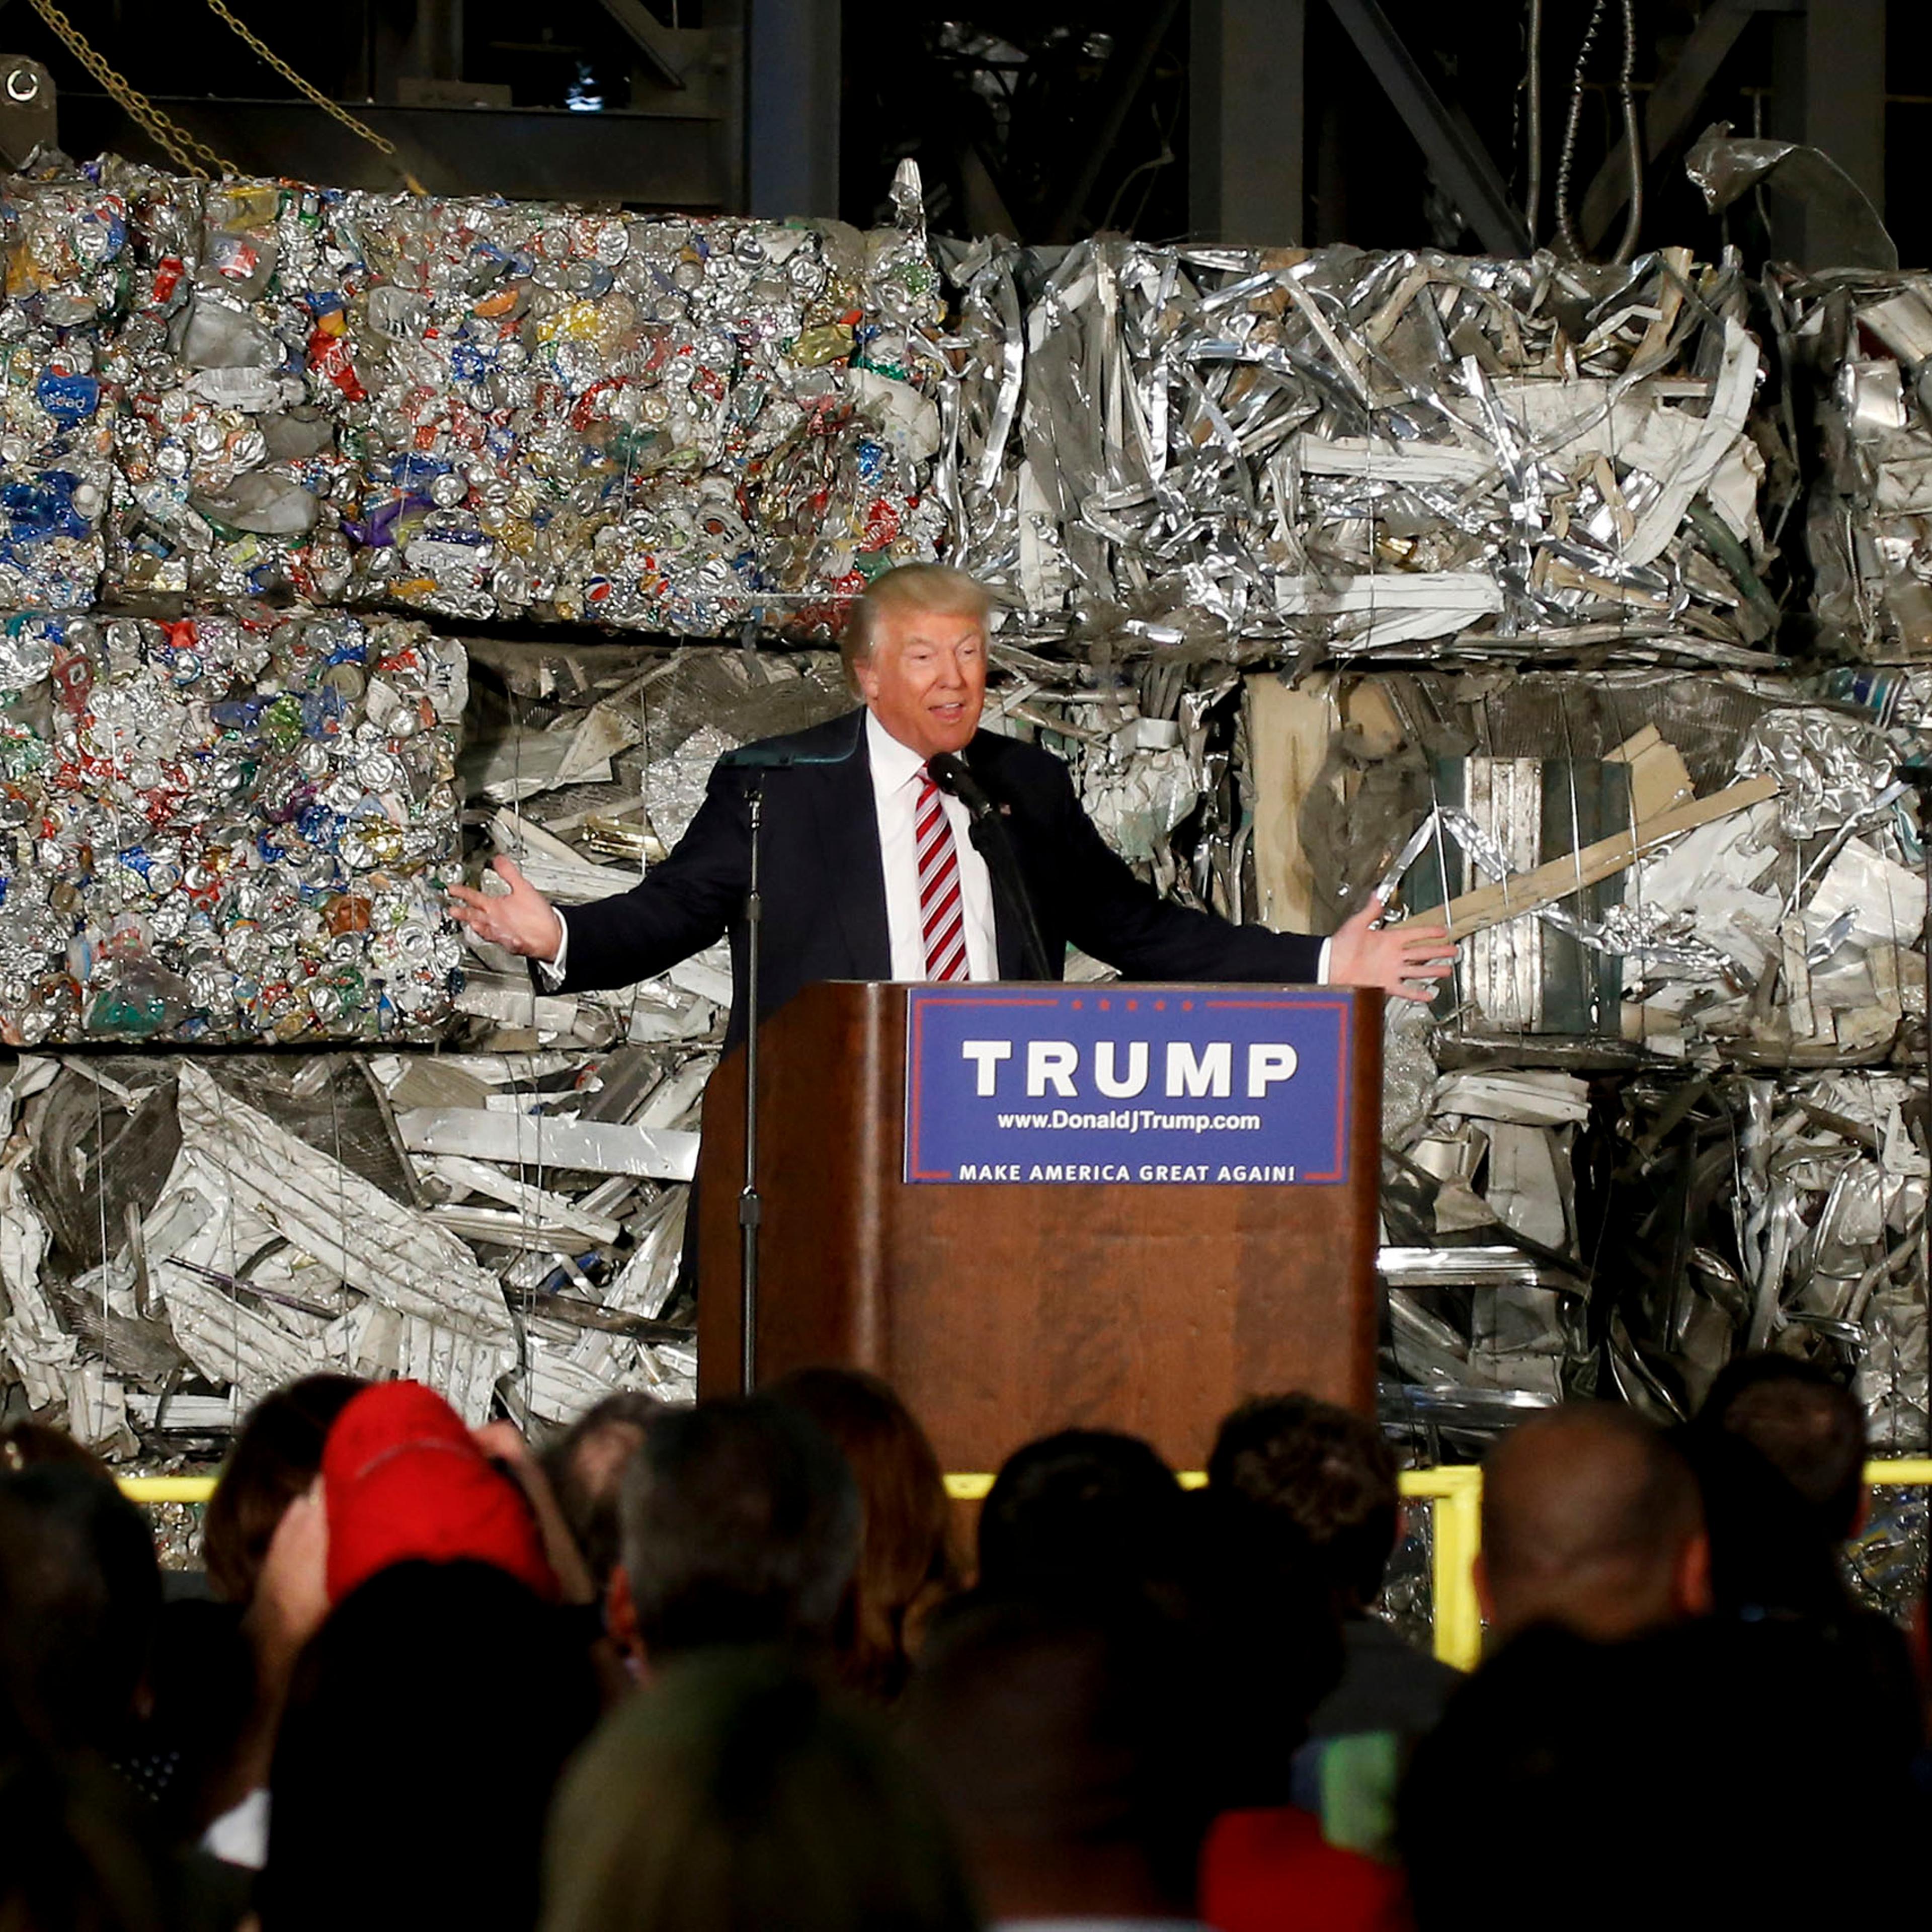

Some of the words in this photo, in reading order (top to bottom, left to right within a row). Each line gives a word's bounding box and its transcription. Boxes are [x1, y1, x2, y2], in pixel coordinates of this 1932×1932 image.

[962, 1040, 1298, 1098] TRUMP
[997, 1109, 1261, 1134] www.DonaldJTrump.com
[959, 1164, 1021, 1181] MAKE
[1029, 1165, 1131, 1181] AMERICA
[1139, 1165, 1210, 1182] GREAT
[1217, 1165, 1295, 1182] AGAIN!
